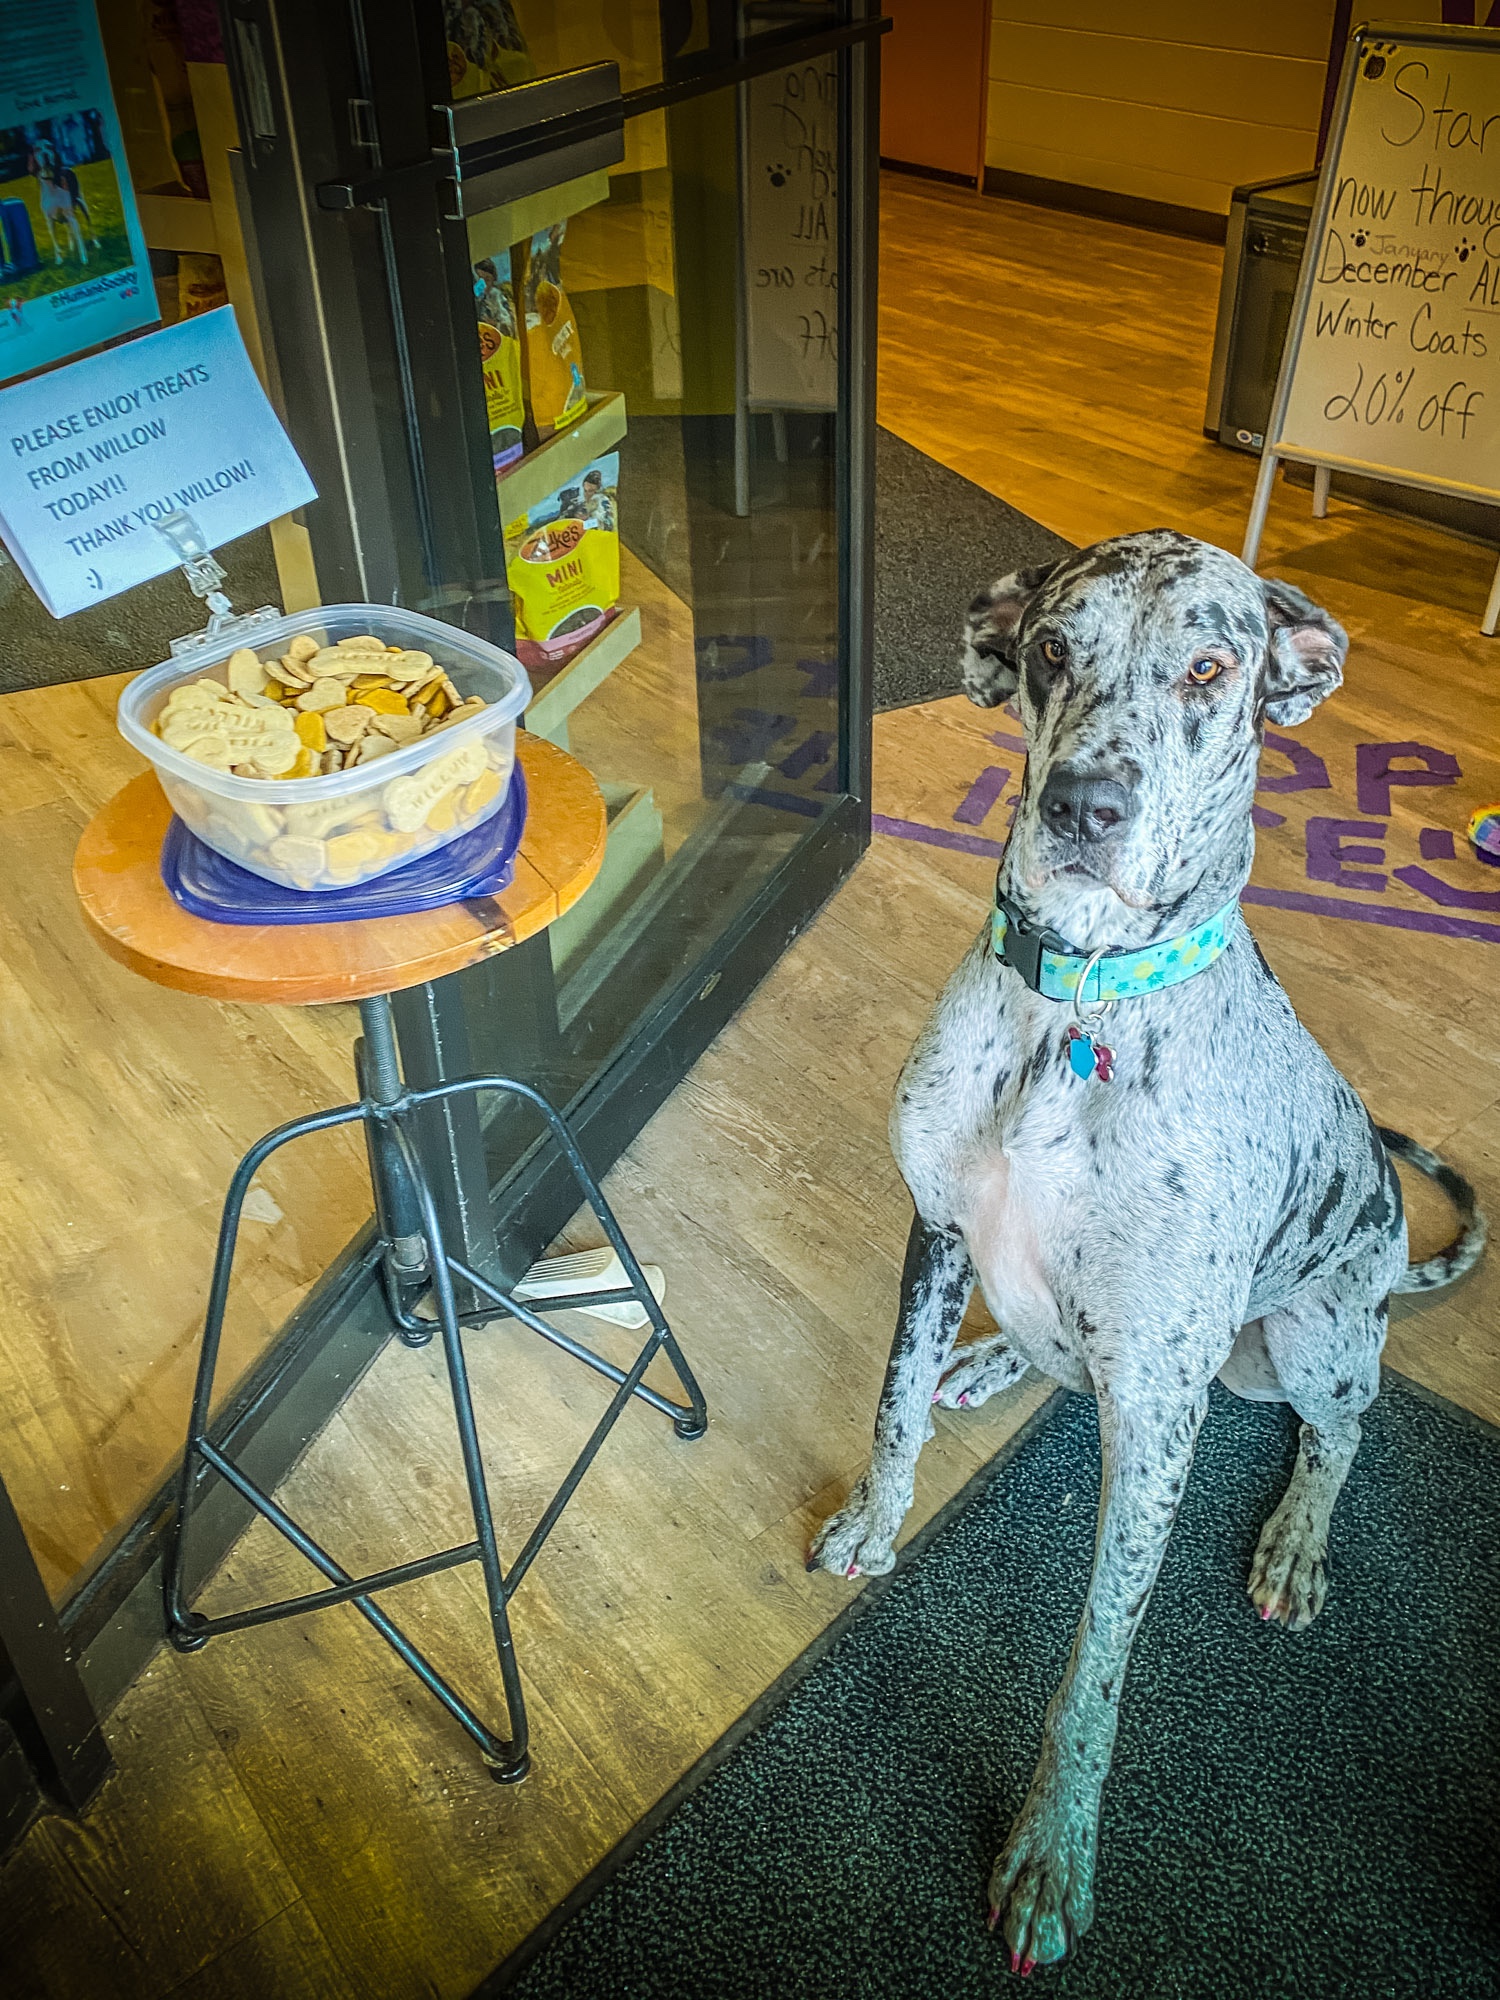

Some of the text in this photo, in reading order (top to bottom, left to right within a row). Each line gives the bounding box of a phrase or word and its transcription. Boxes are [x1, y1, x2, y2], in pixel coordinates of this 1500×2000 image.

[1332, 177, 1396, 220] now
[1317, 228, 1458, 292] December
[1369, 235, 1450, 270] January
[1316, 298, 1488, 357] Winter Coats
[11, 364, 210, 457] PLEASE ENJOY TREATS
[1324, 362, 1485, 440] 20% off
[26, 417, 167, 490] FROM WILLOW
[43, 473, 128, 522] TODAY!!
[64, 459, 257, 557] THANK YOU WILLOW!
[546, 559, 583, 588] MINI
